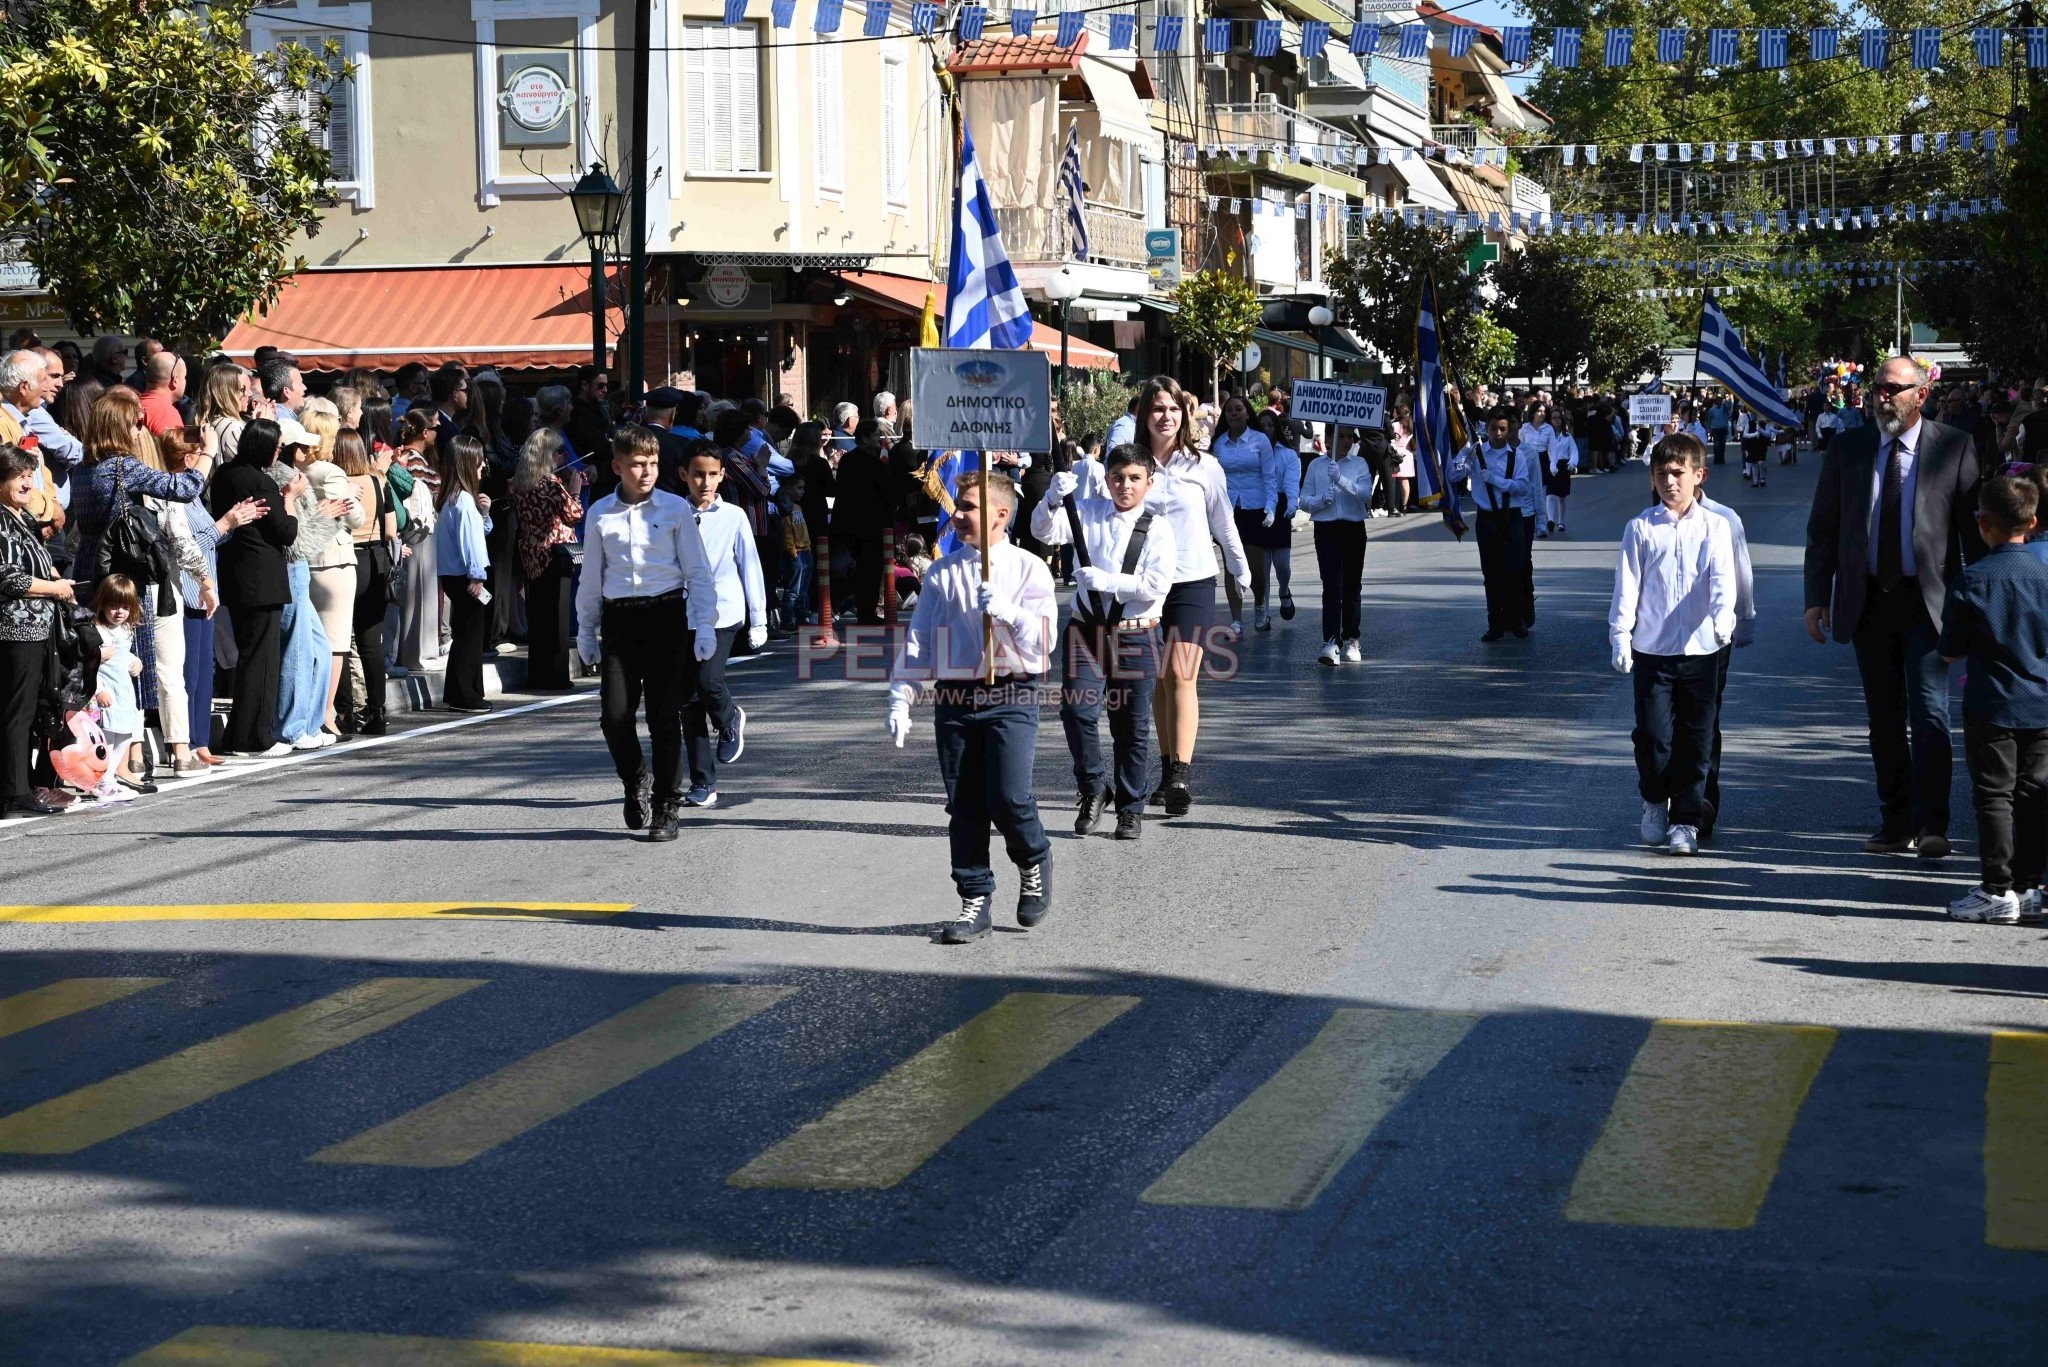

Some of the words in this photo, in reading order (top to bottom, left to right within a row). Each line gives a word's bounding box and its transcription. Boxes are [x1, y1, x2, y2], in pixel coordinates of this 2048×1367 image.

[1365, 2, 1412, 10] ΠΑΘΟΛΟΓΟΣ
[515, 90, 558, 98] καινούργιο
[946, 395, 1025, 409] ΔΗΜΟΤΙΚΟ
[1296, 385, 1342, 401] ΔΗΜΟΤΙΚΟ
[1344, 390, 1382, 405] ΣΧΟΛΕΙΟ
[1300, 400, 1374, 419] ΛΙΠΟΧΩΡΙΟΥ
[950, 420, 1013, 434] ΔΑΦΝΗΣ
